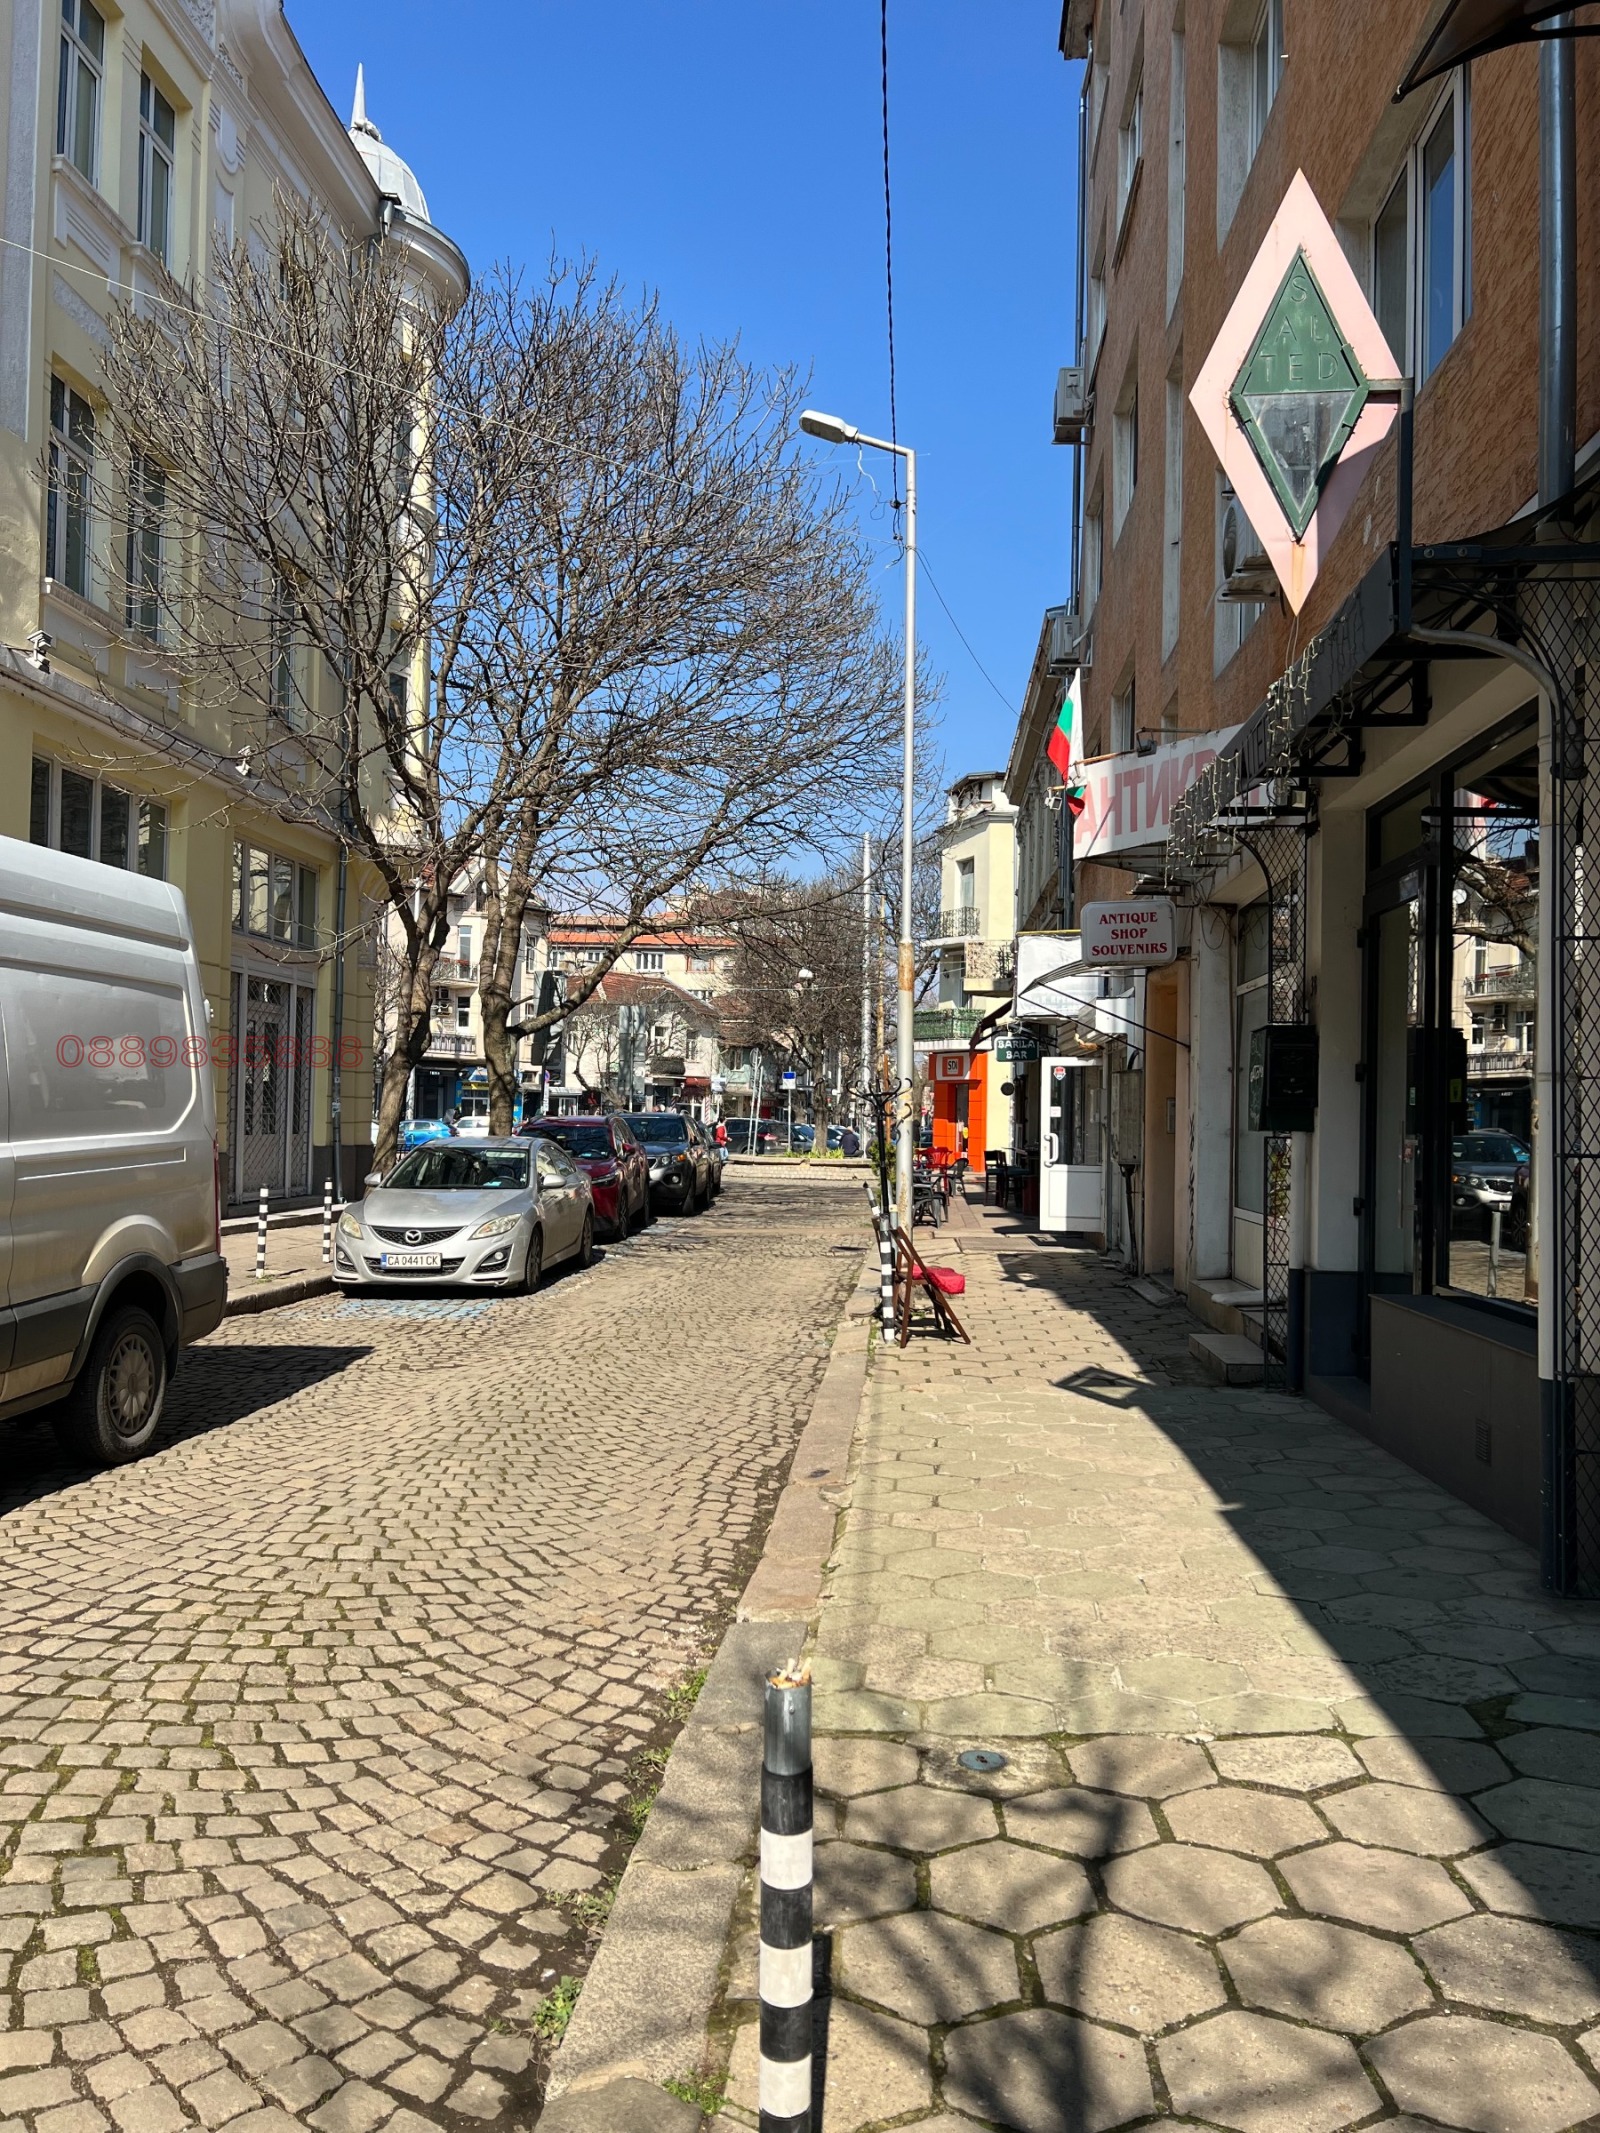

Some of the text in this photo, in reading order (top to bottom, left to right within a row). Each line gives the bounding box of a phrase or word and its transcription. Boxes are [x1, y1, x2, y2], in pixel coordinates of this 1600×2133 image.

[1291, 275, 1307, 303] S
[1275, 315, 1325, 343] AL
[1259, 352, 1339, 382] TED
[1099, 912, 1158, 924] ANTIQUE
[1111, 928, 1148, 940] SHOP
[1091, 942, 1168, 956] SOUVENIRS
[1005, 1050, 1027, 1060] BAR
[387, 1255, 438, 1265] CA 0441 CK
